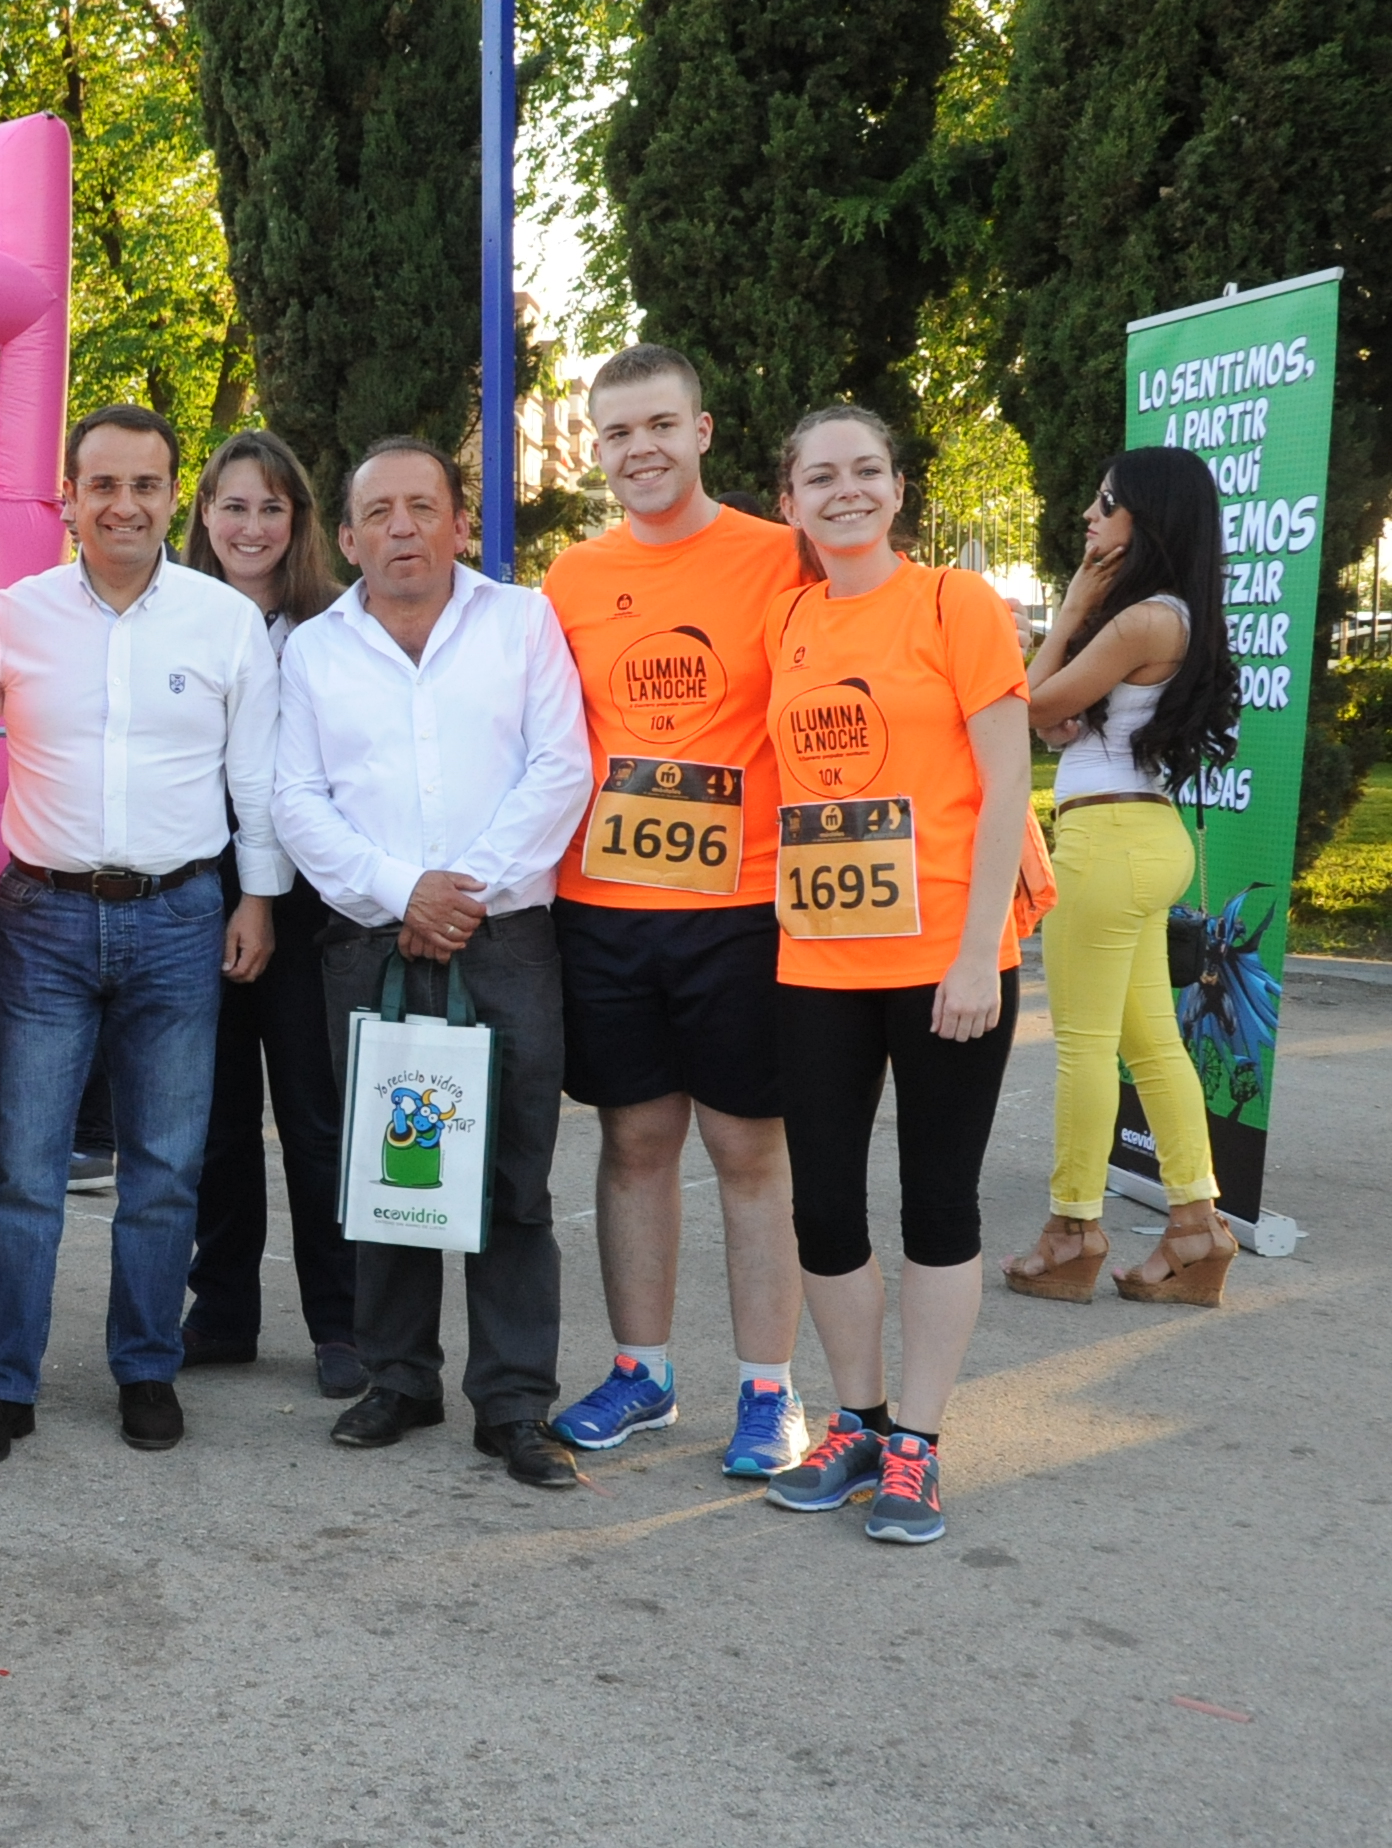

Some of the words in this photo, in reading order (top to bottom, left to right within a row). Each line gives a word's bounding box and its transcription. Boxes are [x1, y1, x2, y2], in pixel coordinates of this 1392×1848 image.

[1138, 368, 1167, 412] LO
[1163, 413, 1177, 448] A
[1221, 495, 1318, 553] EMOS
[1225, 612, 1291, 656] EGAR
[626, 655, 707, 682] ILUMINA
[651, 714, 675, 731] 10K
[790, 703, 867, 734] ILUMINA
[818, 767, 843, 786] 10K
[601, 813, 728, 867] 1696
[789, 863, 899, 911] 1695
[387, 1070, 425, 1088] reciclo
[373, 1206, 448, 1225] ecovidrio
